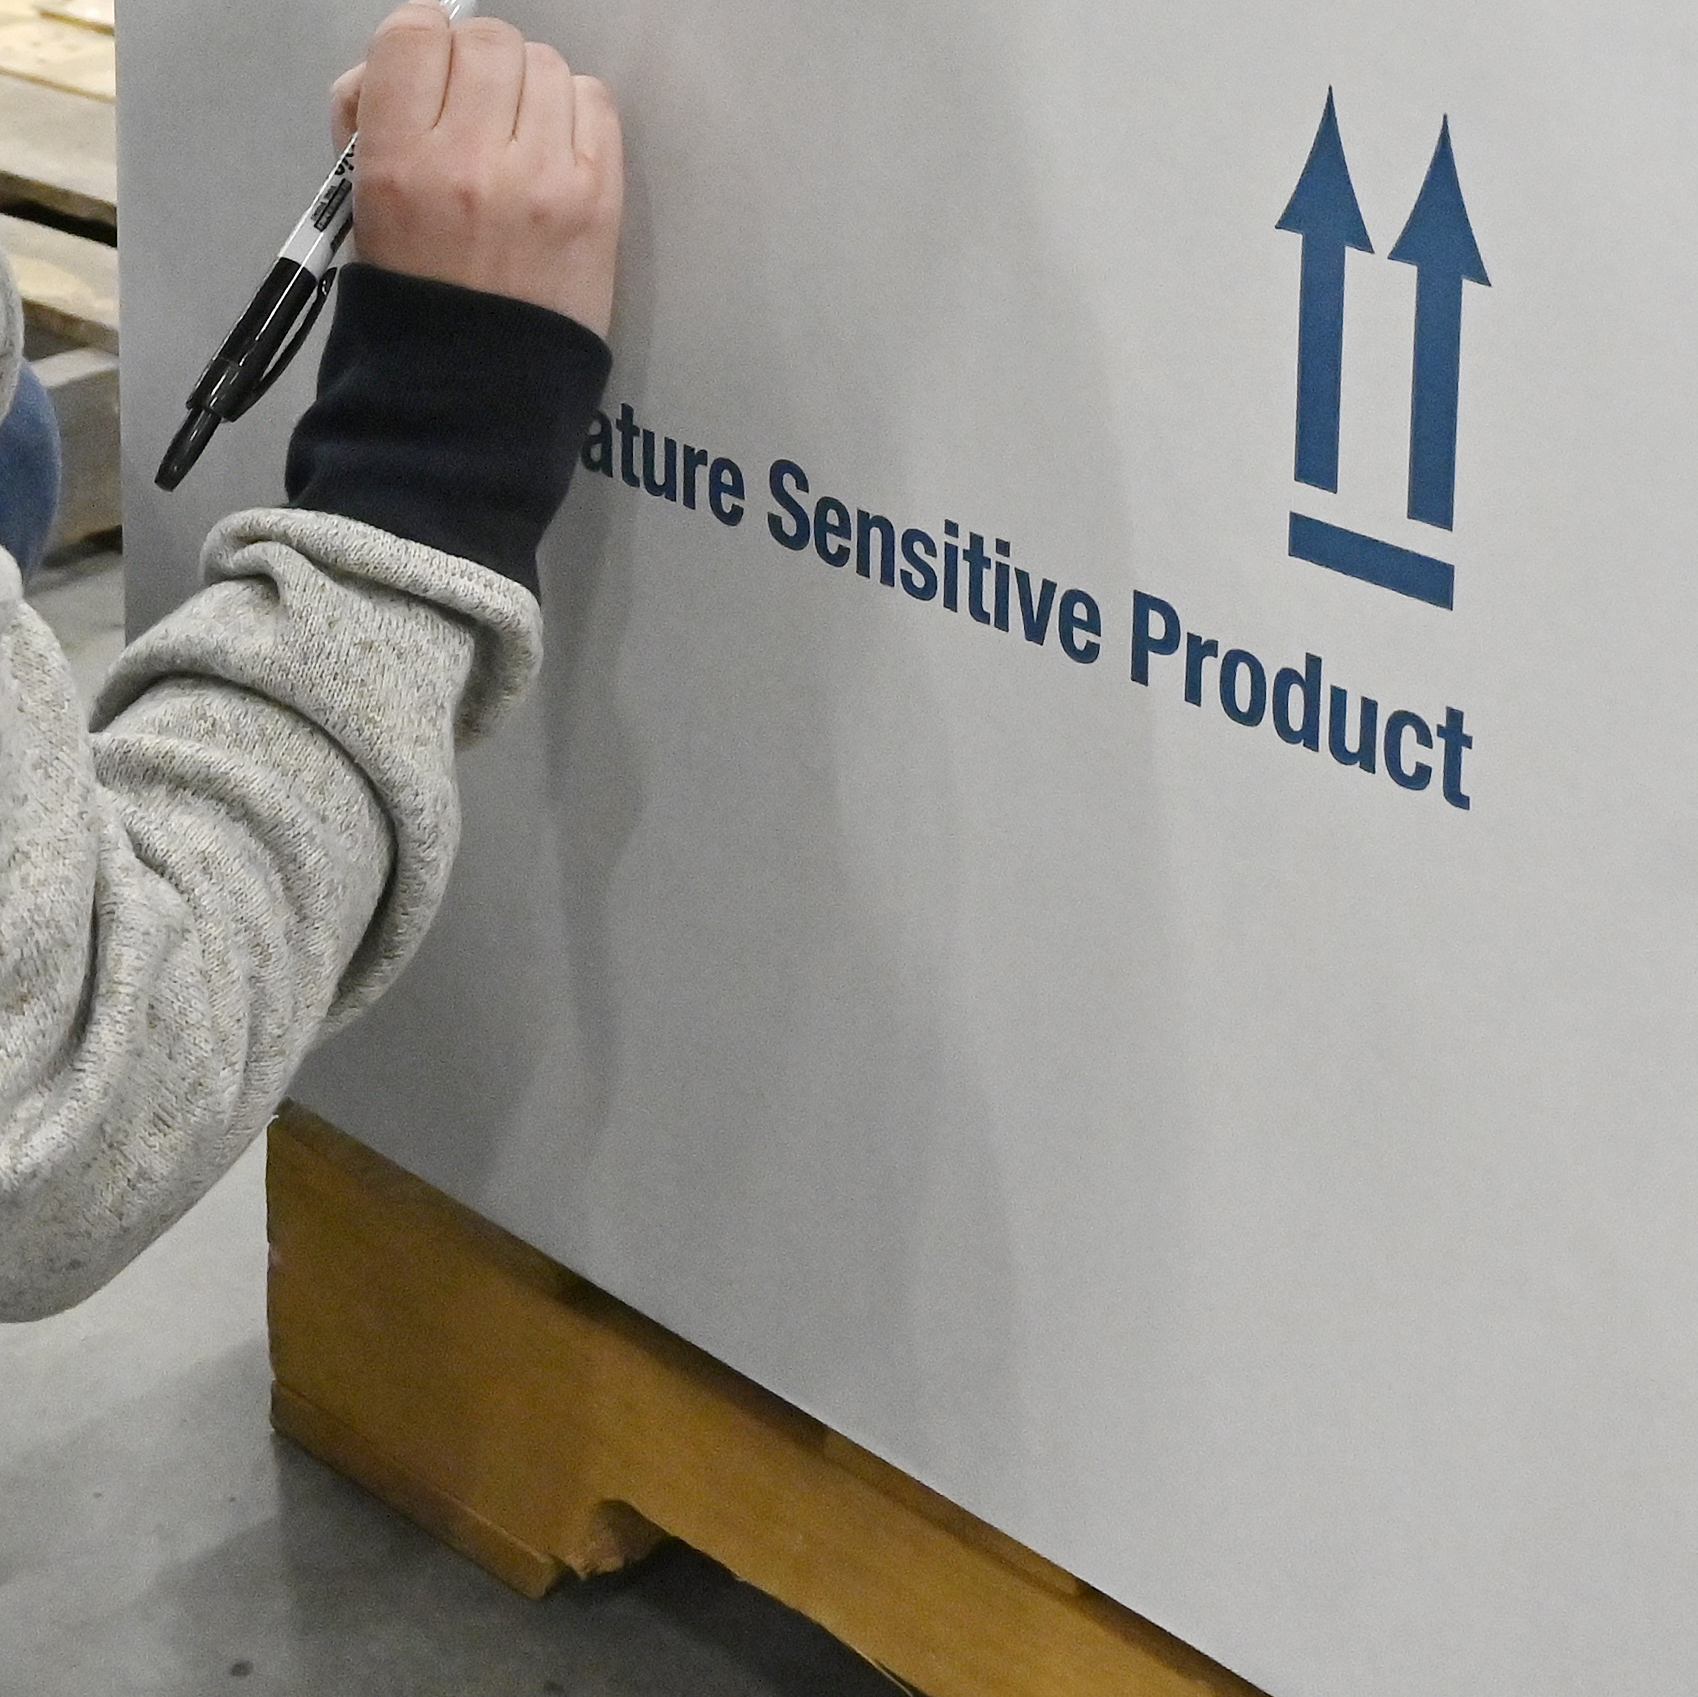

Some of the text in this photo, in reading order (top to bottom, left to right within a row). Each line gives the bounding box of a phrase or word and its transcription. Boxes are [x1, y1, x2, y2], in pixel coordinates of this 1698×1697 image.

[580, 402, 1474, 812] ature Sensitive Product
